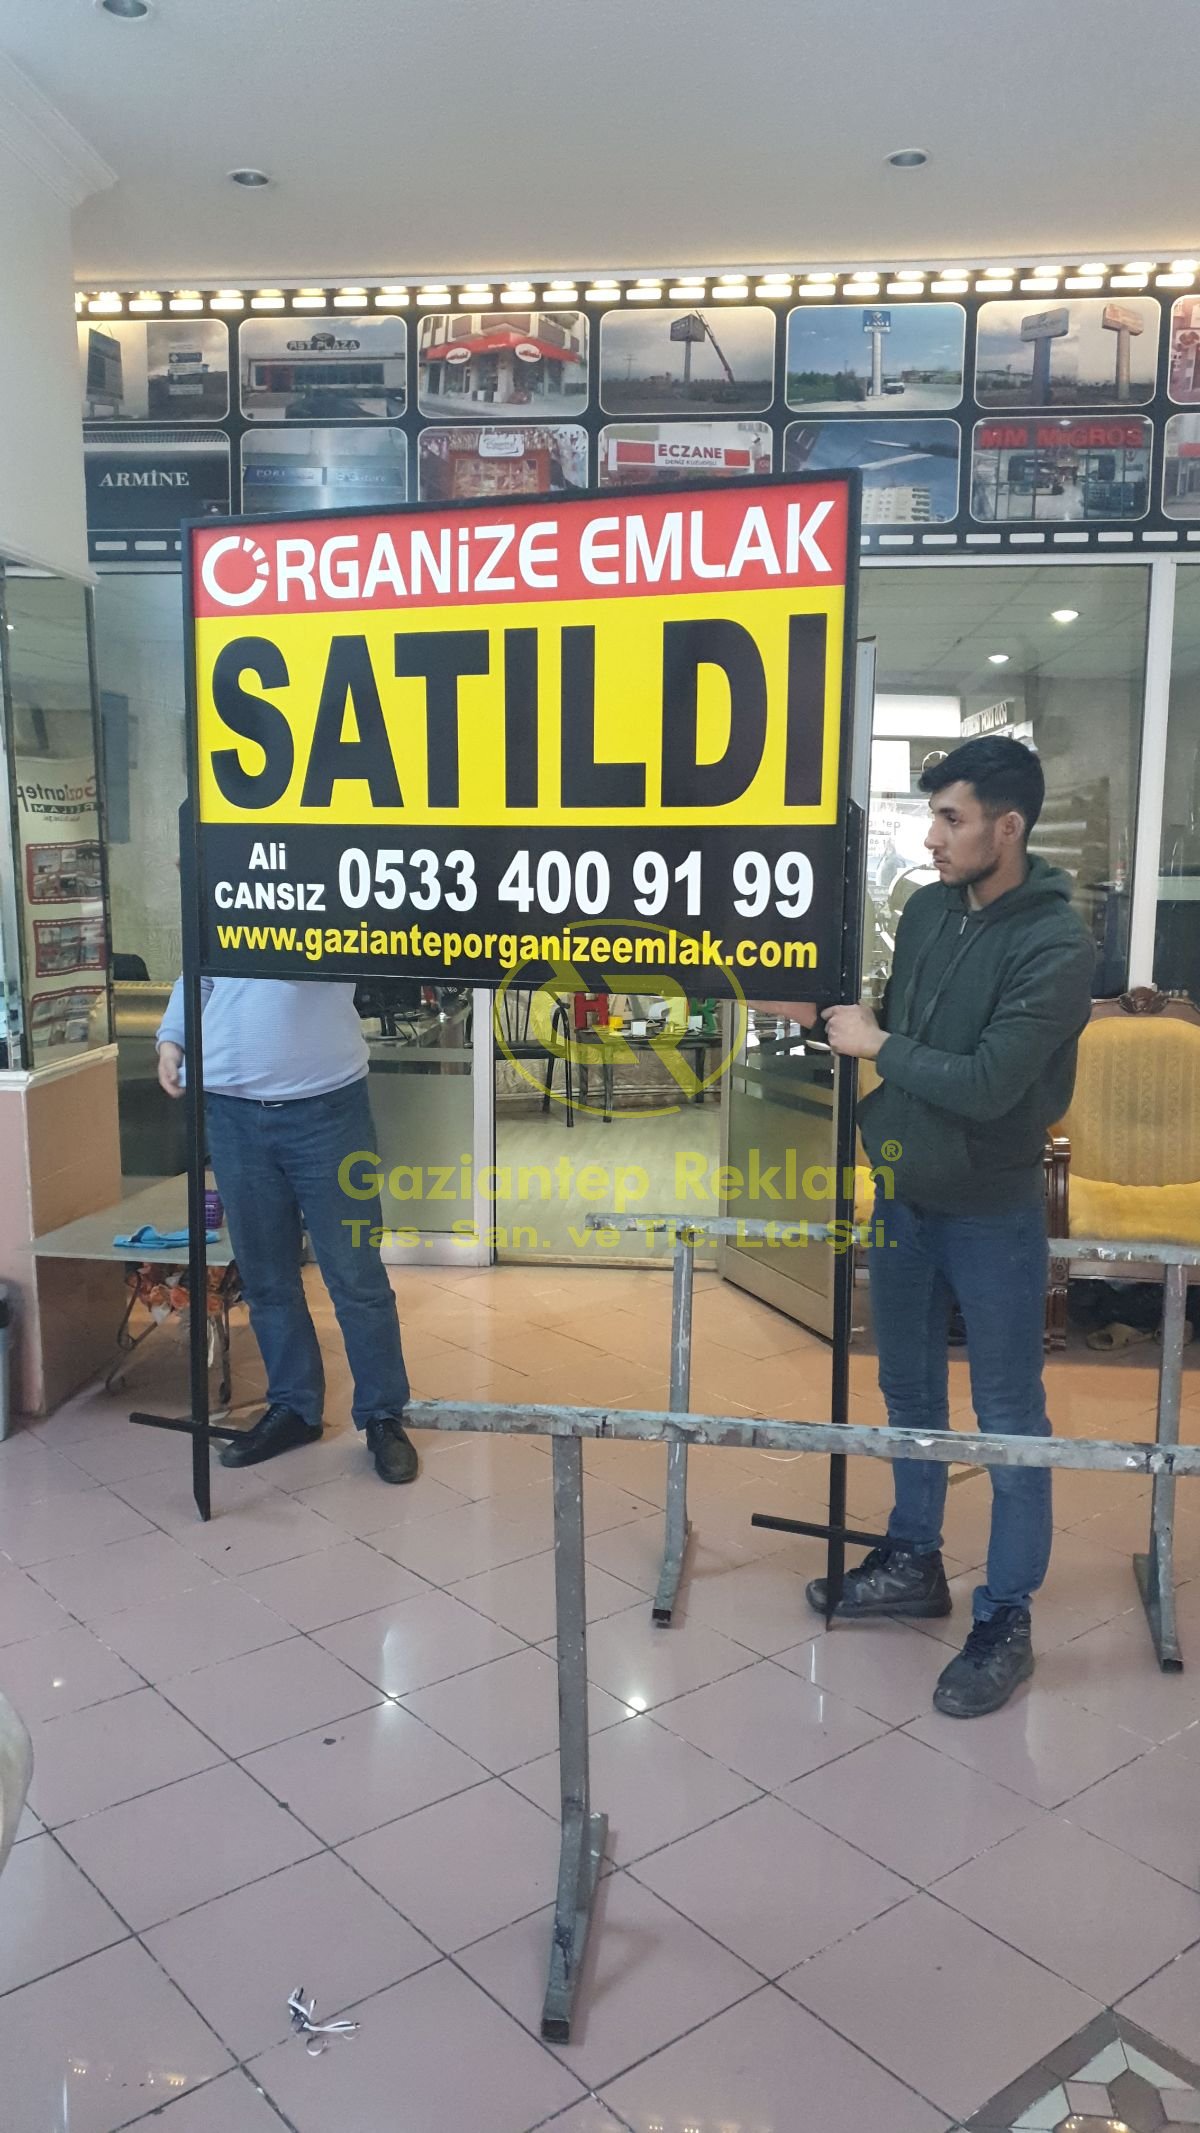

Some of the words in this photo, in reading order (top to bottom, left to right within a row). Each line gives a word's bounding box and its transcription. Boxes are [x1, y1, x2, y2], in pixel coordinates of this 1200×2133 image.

[316, 341, 358, 350] PLAZA
[658, 444, 722, 458] ECZANE
[579, 500, 836, 586] EMLAK
[210, 612, 828, 809] SATILDI
[249, 843, 287, 870] Ali
[214, 881, 326, 912] CANSIZ
[338, 848, 478, 910] 0533
[498, 850, 610, 914] 400
[633, 850, 702, 915] 91
[732, 850, 815, 918] 99
[217, 921, 818, 969] www.gazianteporganizeemlak.com
